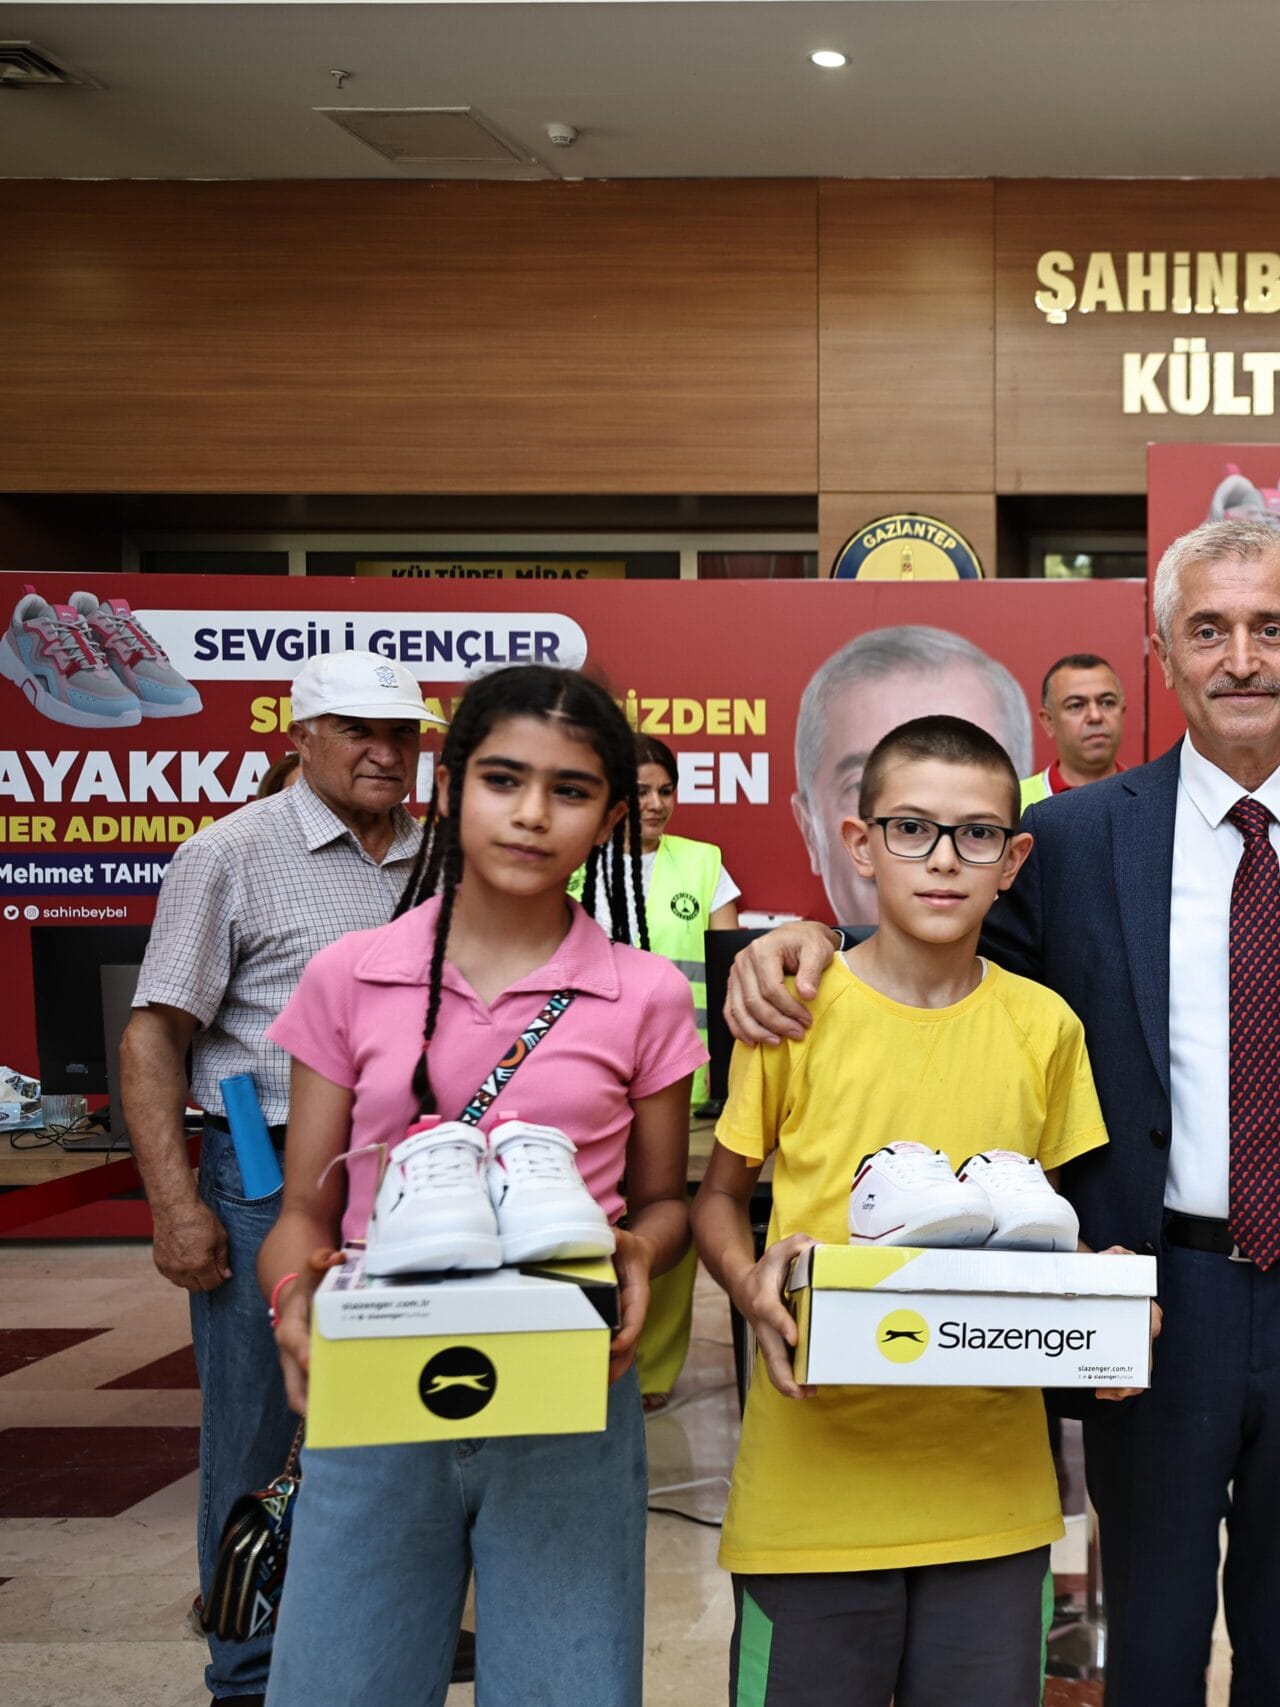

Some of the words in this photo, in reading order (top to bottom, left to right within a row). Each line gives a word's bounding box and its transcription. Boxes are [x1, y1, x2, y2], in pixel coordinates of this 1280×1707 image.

[368, 629, 560, 668] GENÇLER
[613, 689, 766, 735] İZDEN
[0, 816, 57, 842] ER
[43, 906, 127, 921] sahinbeybel
[938, 1321, 1097, 1357] Slazenger
